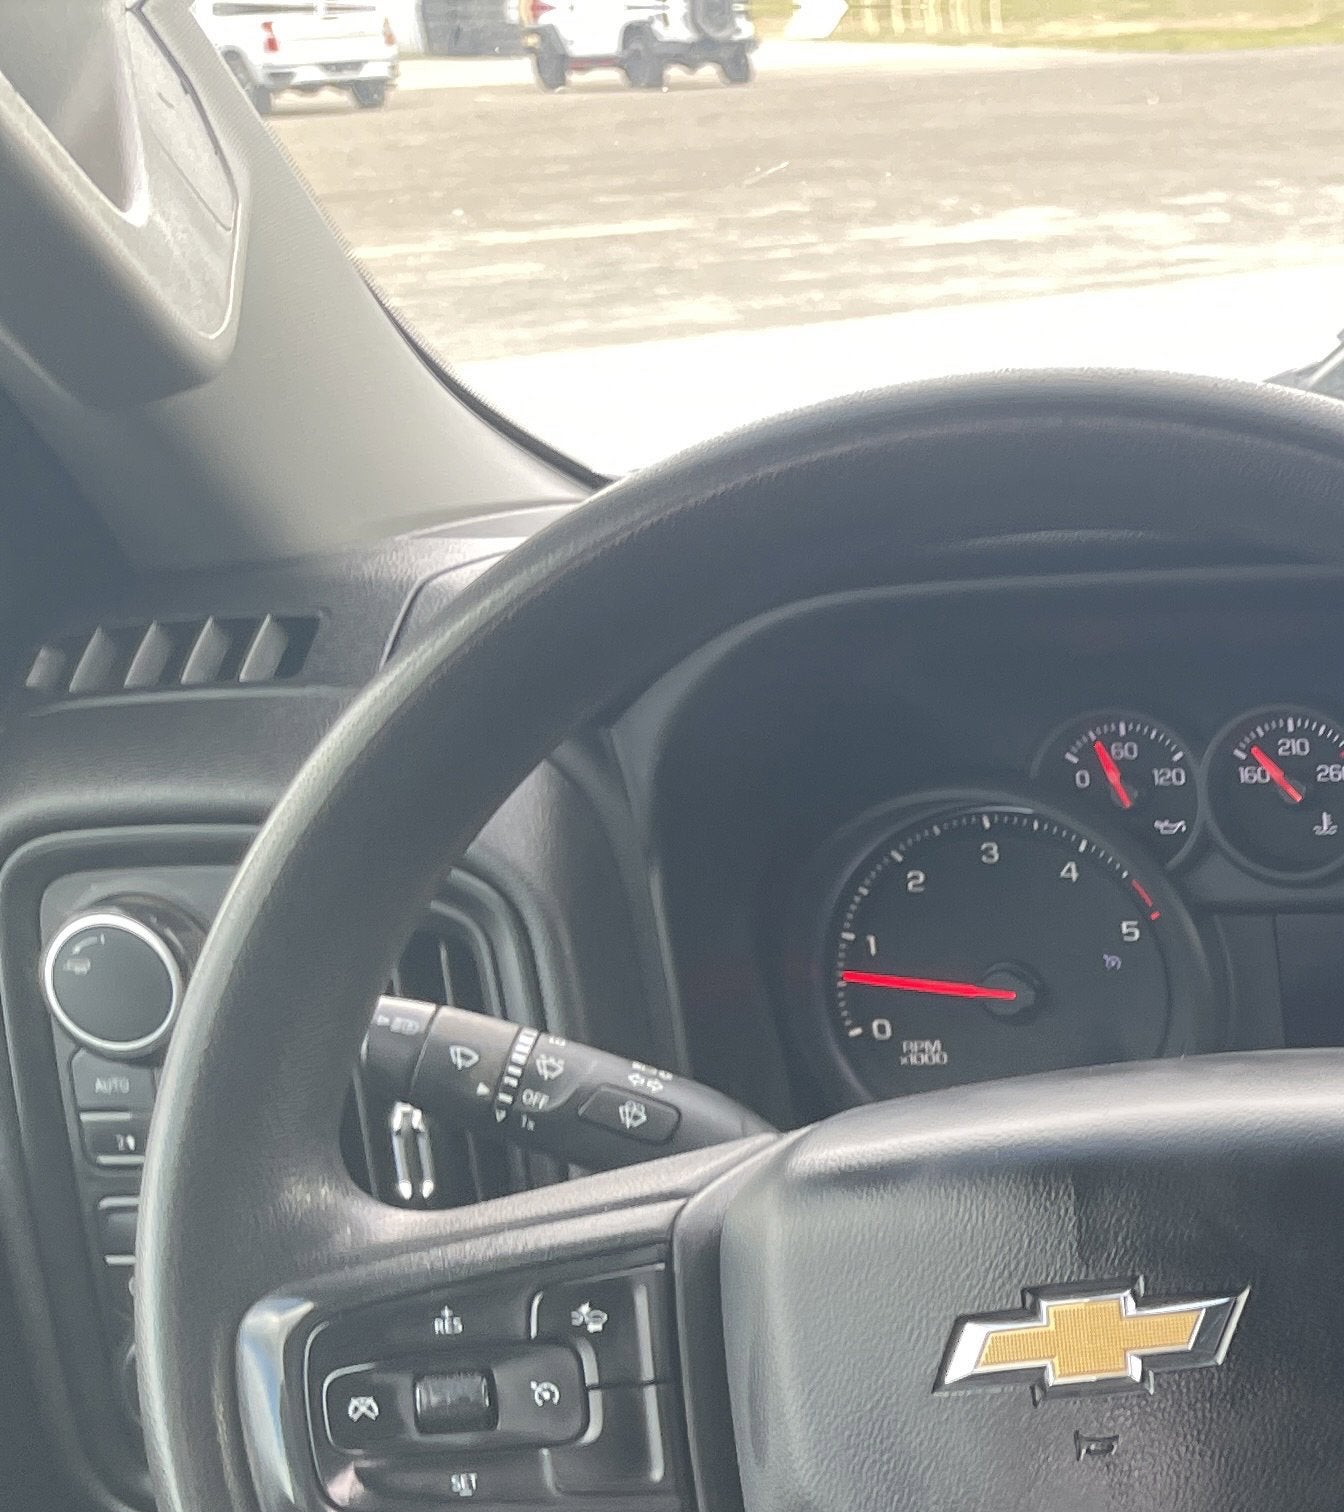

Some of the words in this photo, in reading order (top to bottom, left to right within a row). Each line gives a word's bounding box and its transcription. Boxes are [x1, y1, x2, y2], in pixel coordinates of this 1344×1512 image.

[1111, 742, 1138, 760] 60
[1278, 738, 1310, 756] 210
[1075, 769, 1091, 788] 0
[1153, 767, 1186, 786] 120
[1239, 766, 1270, 784] 160
[980, 842, 1000, 864] 3
[906, 869, 926, 893] 2
[1059, 861, 1080, 883] 4
[1120, 920, 1141, 942] 5
[864, 934, 877, 956] 1
[871, 1018, 893, 1041] 0
[902, 1039, 943, 1055] RPM
[95, 1077, 130, 1094] AUTO
[522, 1088, 550, 1110] OFF
